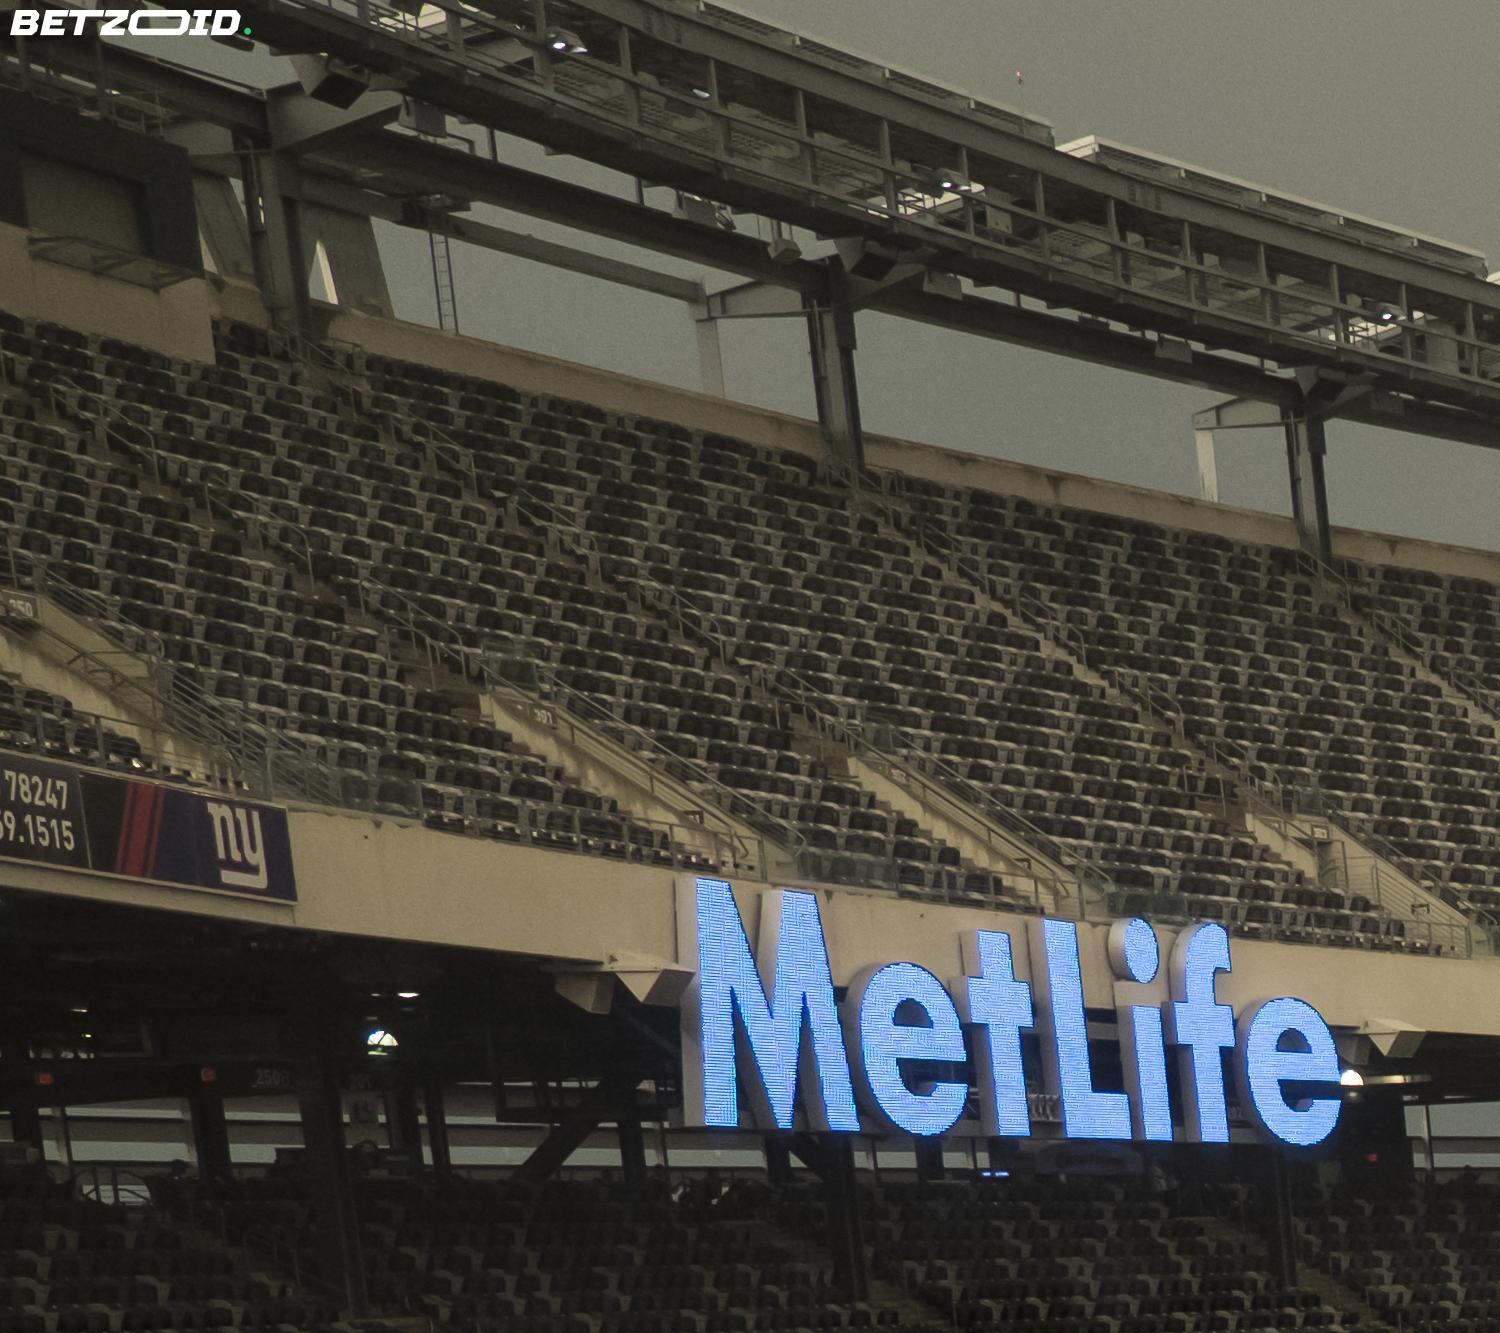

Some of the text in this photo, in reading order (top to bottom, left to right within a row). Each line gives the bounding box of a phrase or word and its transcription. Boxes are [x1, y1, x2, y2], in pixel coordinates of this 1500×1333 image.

[5, 769, 67, 810] 78247
[207, 802, 268, 889] ny
[697, 877, 1342, 1145] MetLife
